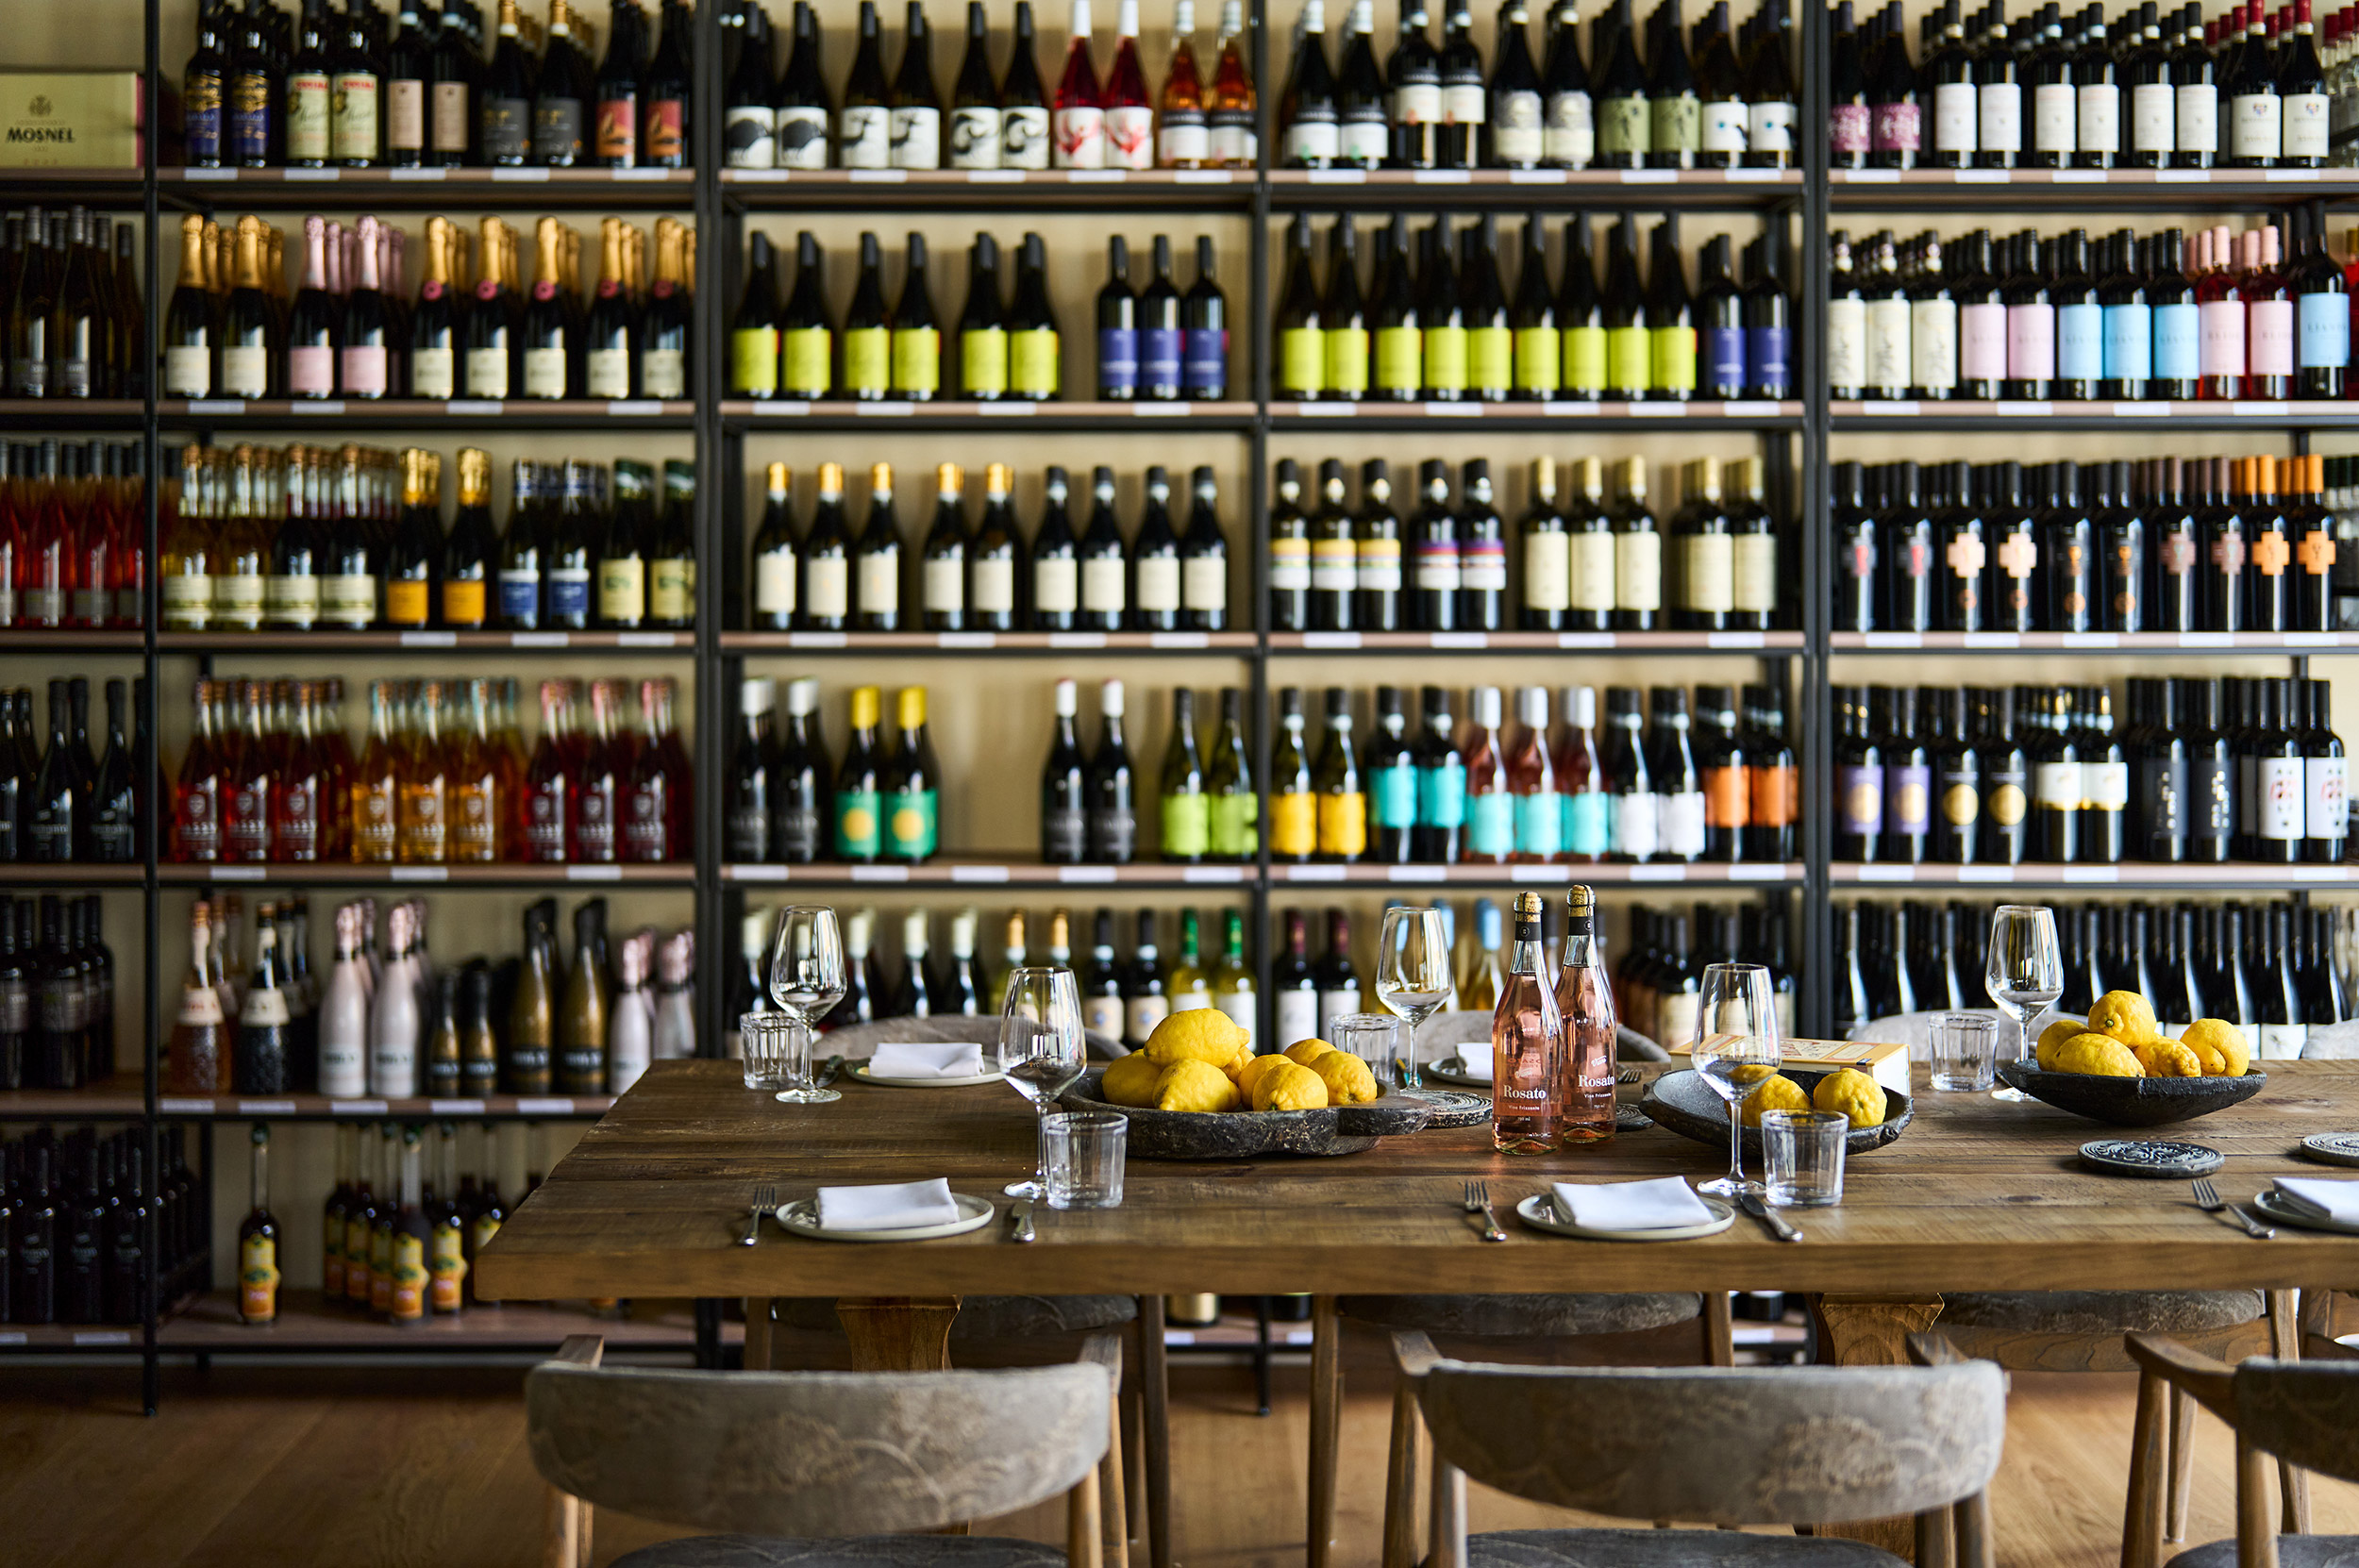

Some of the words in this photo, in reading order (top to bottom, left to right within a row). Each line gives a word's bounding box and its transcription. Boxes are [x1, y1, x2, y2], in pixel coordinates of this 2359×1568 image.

[6, 126, 75, 143] MOSNEL
[1579, 1075, 1614, 1087] Rosato
[1503, 1085, 1547, 1098] Rosato
